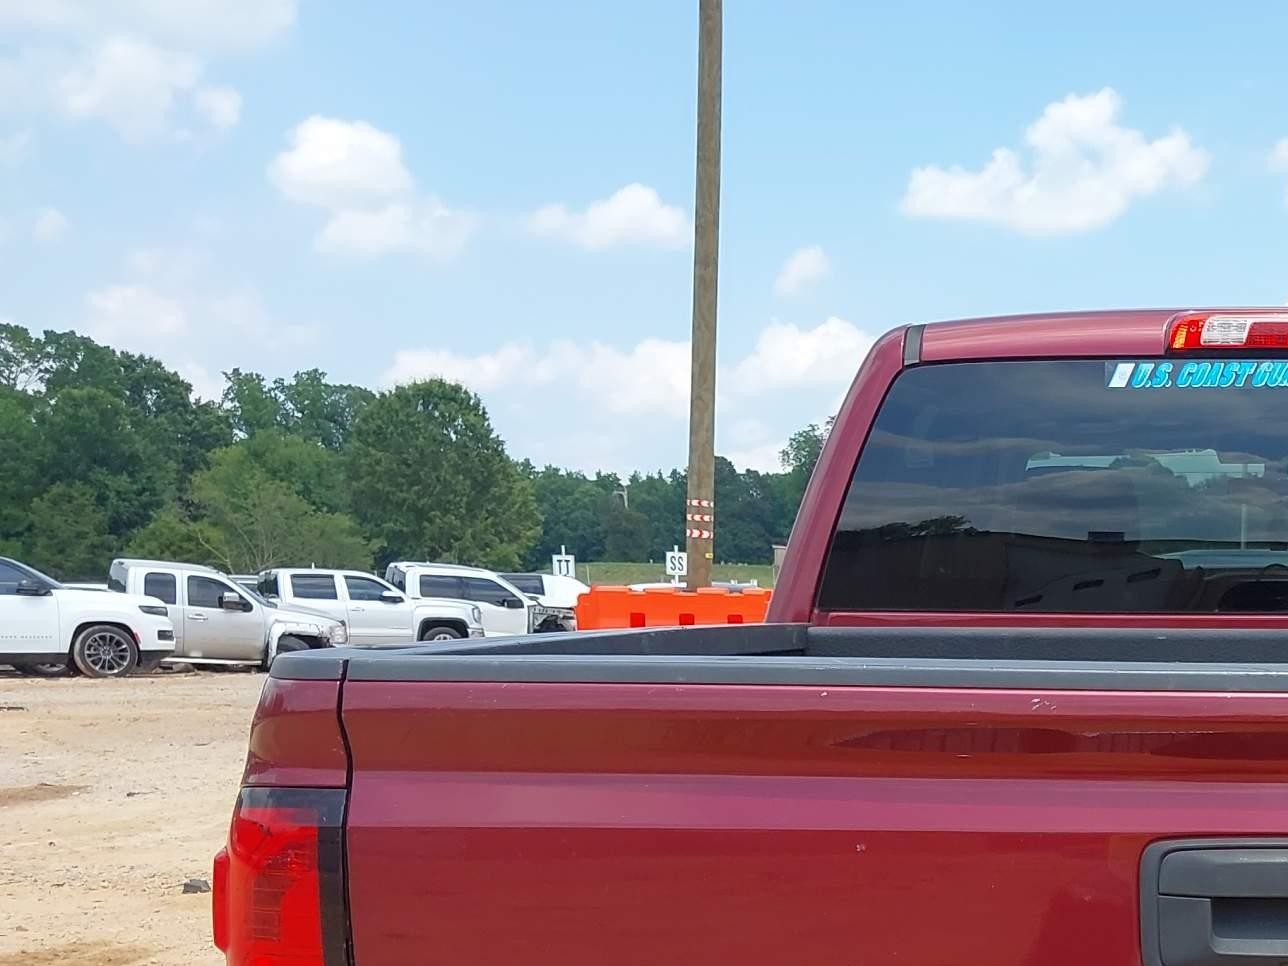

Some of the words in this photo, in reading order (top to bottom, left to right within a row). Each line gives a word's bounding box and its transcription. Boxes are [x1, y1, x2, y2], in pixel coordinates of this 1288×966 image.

[1131, 362, 1173, 388] U.S.
[1176, 362, 1255, 387] COAST
[556, 559, 571, 576] TT
[670, 556, 684, 572] SS
